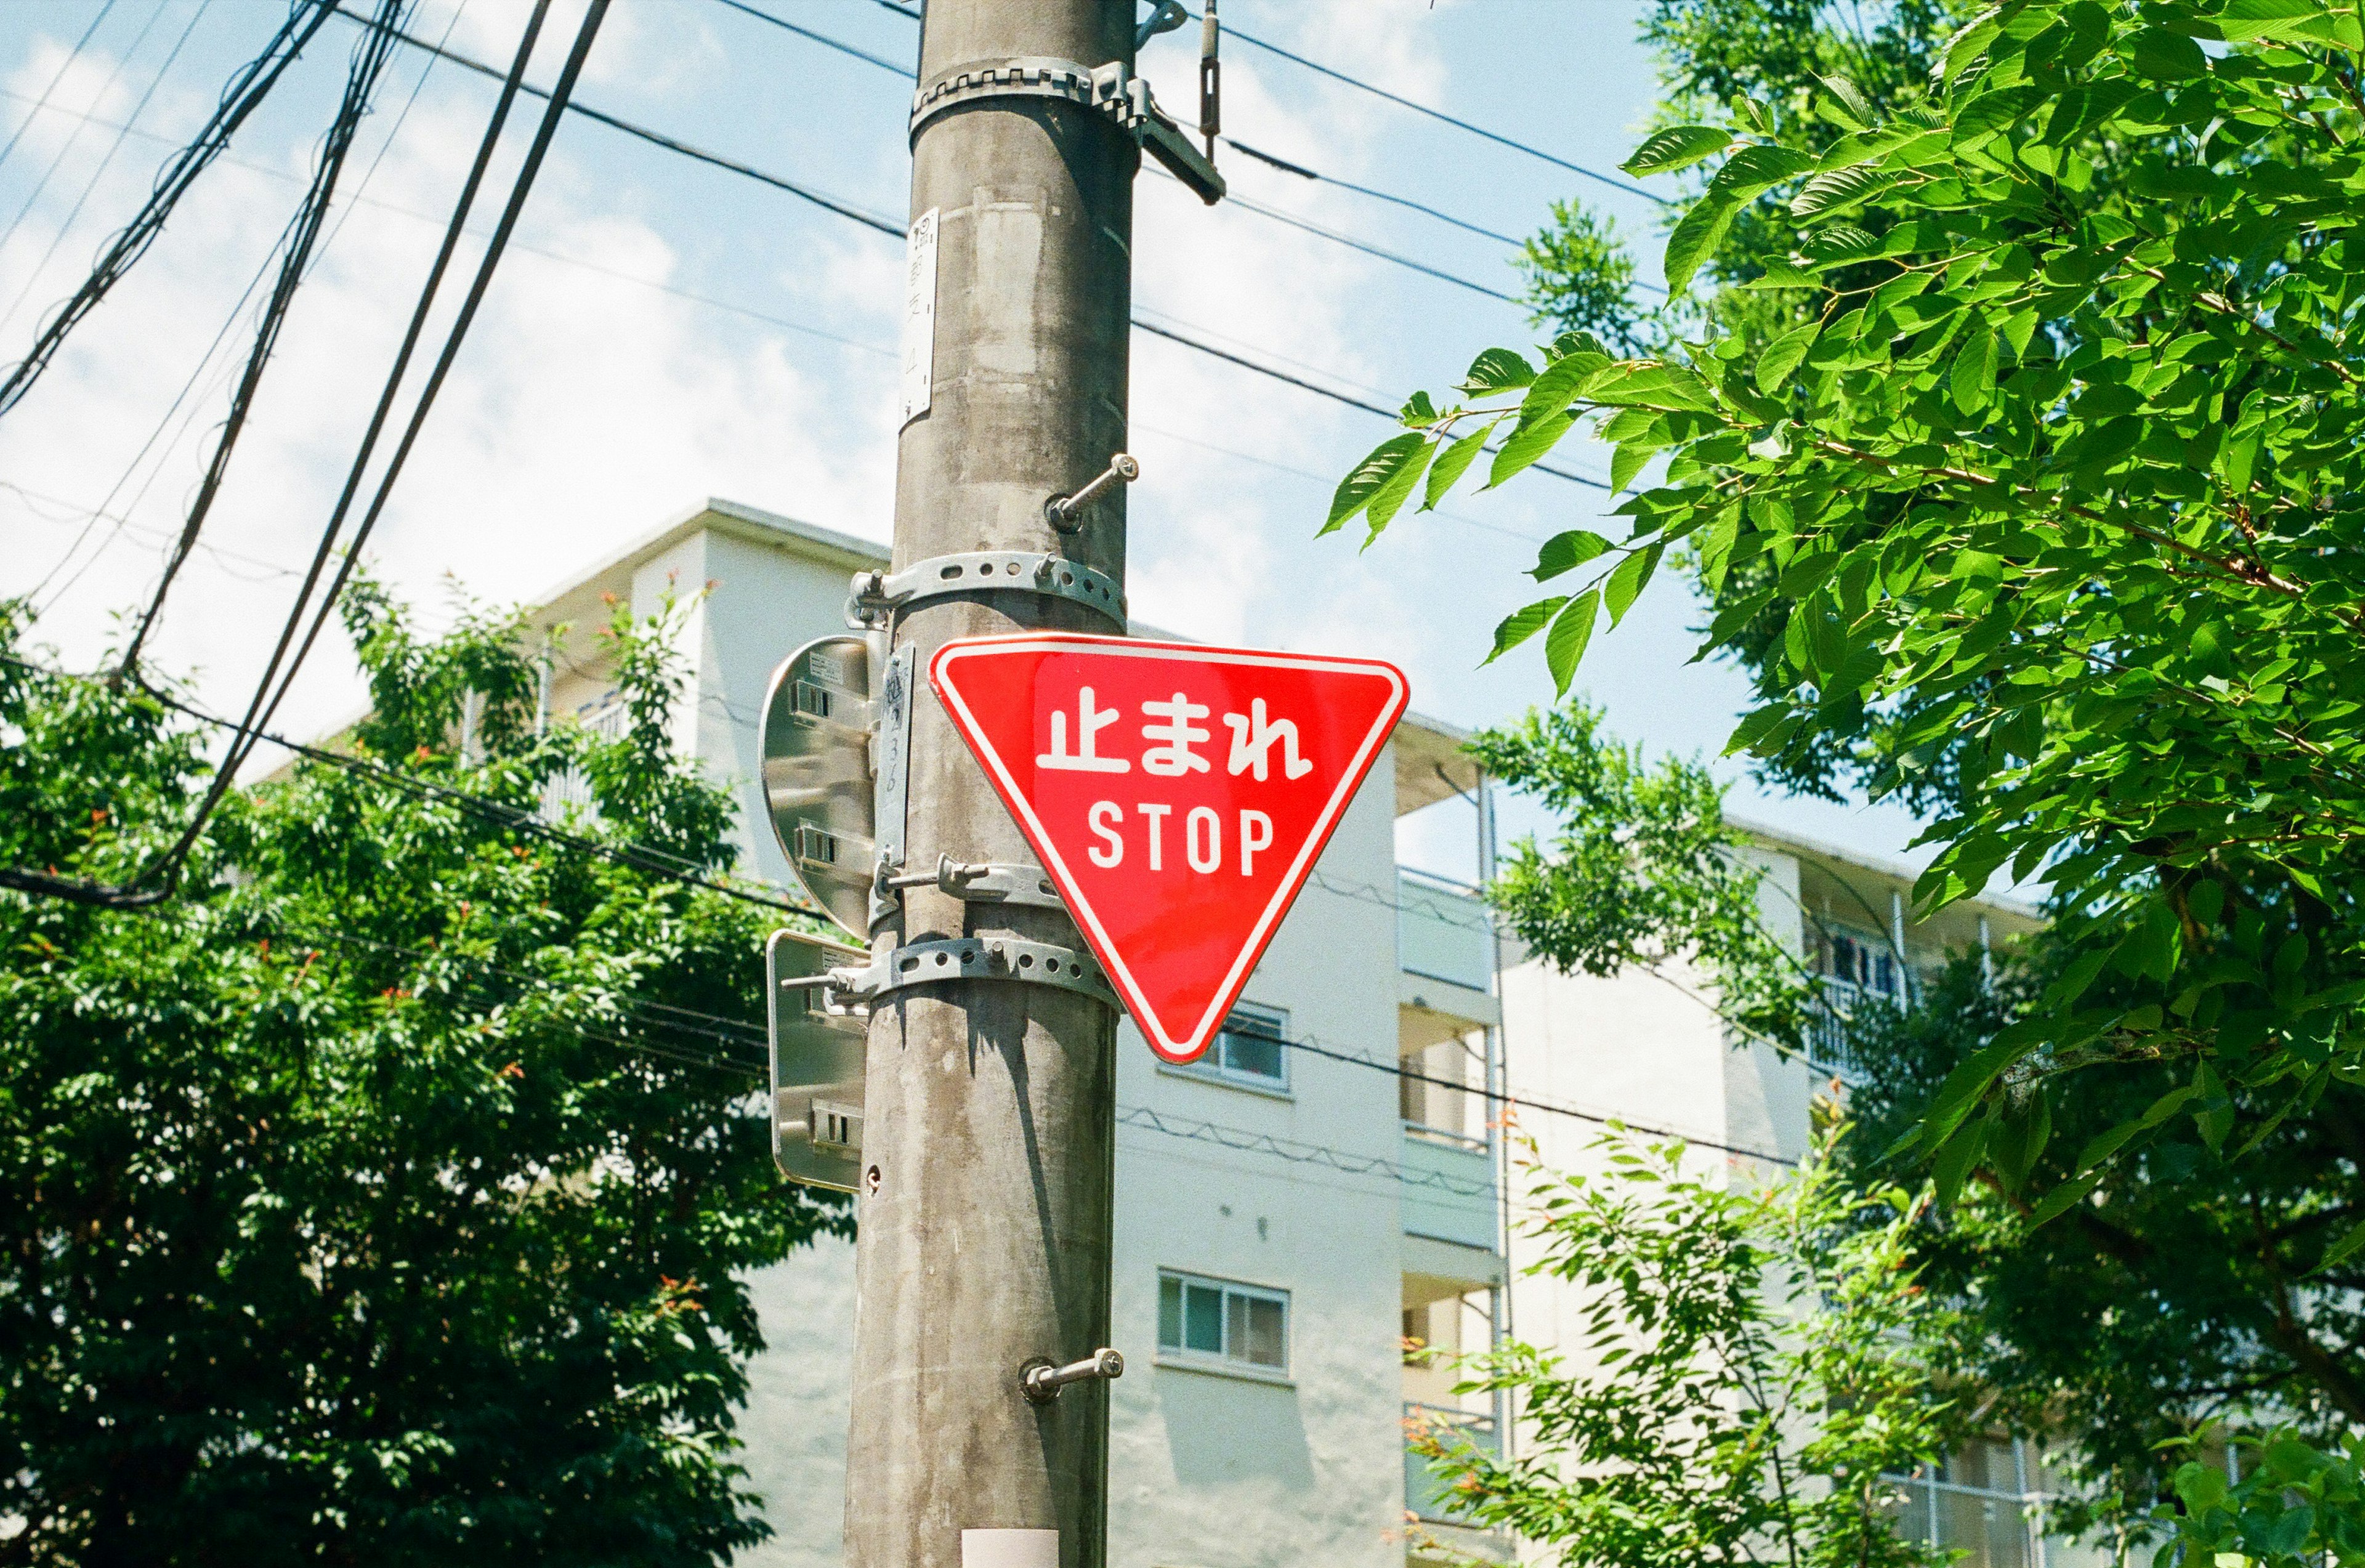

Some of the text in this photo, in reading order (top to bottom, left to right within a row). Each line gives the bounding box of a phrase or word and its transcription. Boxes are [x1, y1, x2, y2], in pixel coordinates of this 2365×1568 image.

[1037, 686, 1312, 781] 止まれ
[1088, 801, 1274, 876] STOP
